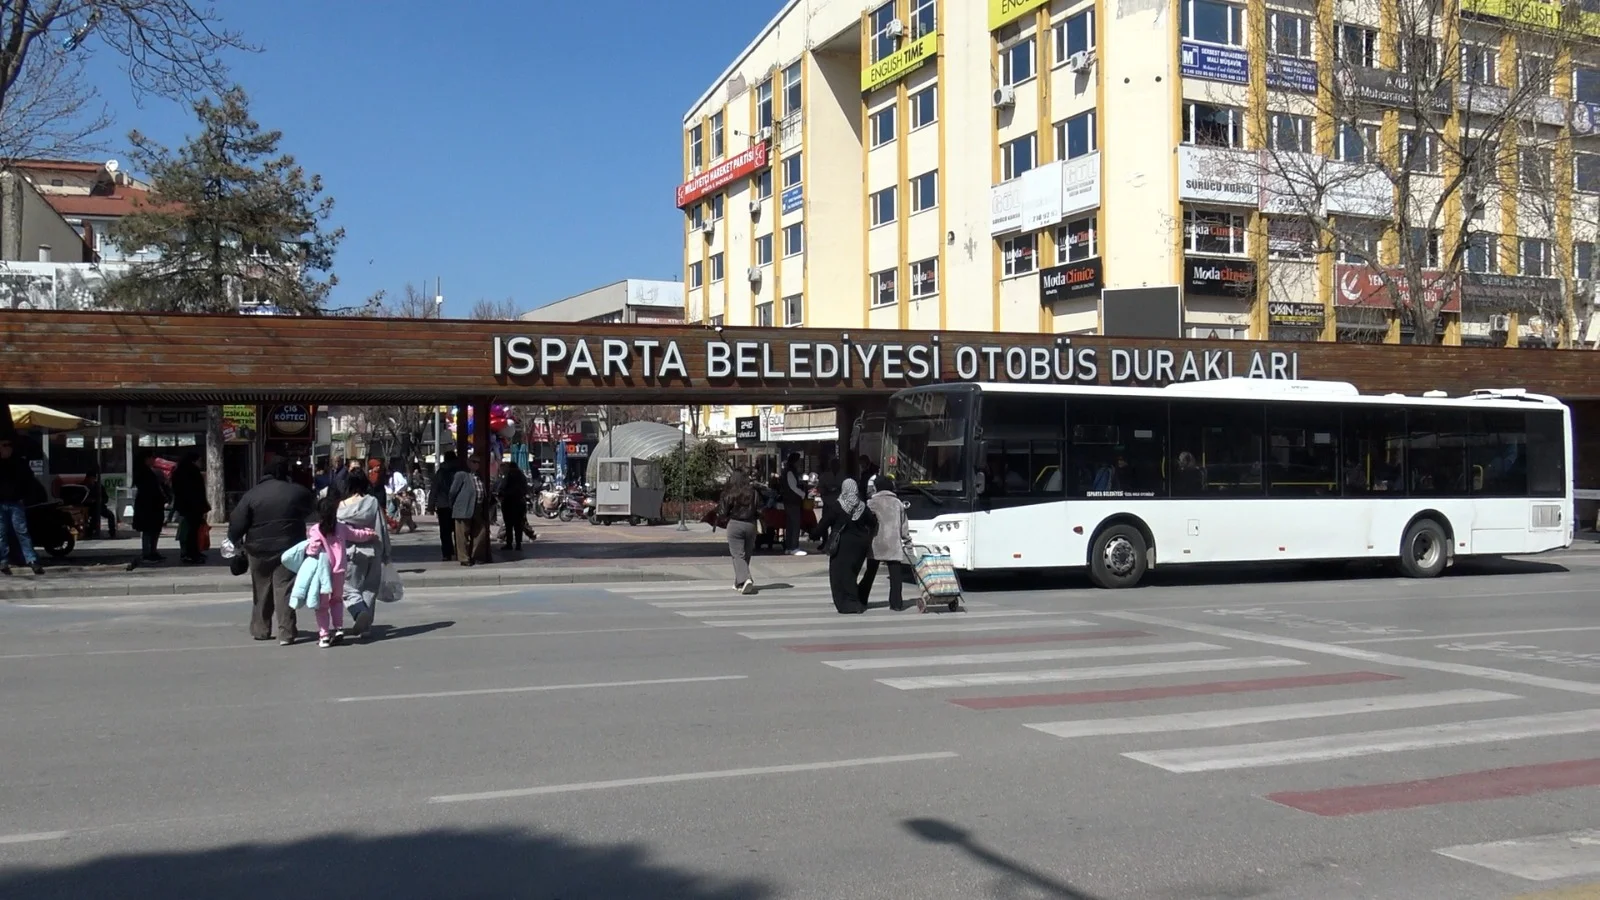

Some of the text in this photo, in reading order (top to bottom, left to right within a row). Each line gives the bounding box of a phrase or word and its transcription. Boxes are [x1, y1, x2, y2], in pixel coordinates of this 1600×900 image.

[870, 52, 903, 83] ENGLISH
[903, 41, 924, 65] TIME
[710, 161, 734, 182] HAREKET
[494, 336, 687, 377] ISPARTA
[707, 333, 940, 379] BELEDİYESİ
[956, 338, 1098, 381] OTOBÜS
[274, 413, 307, 421] KÖFTECİ
